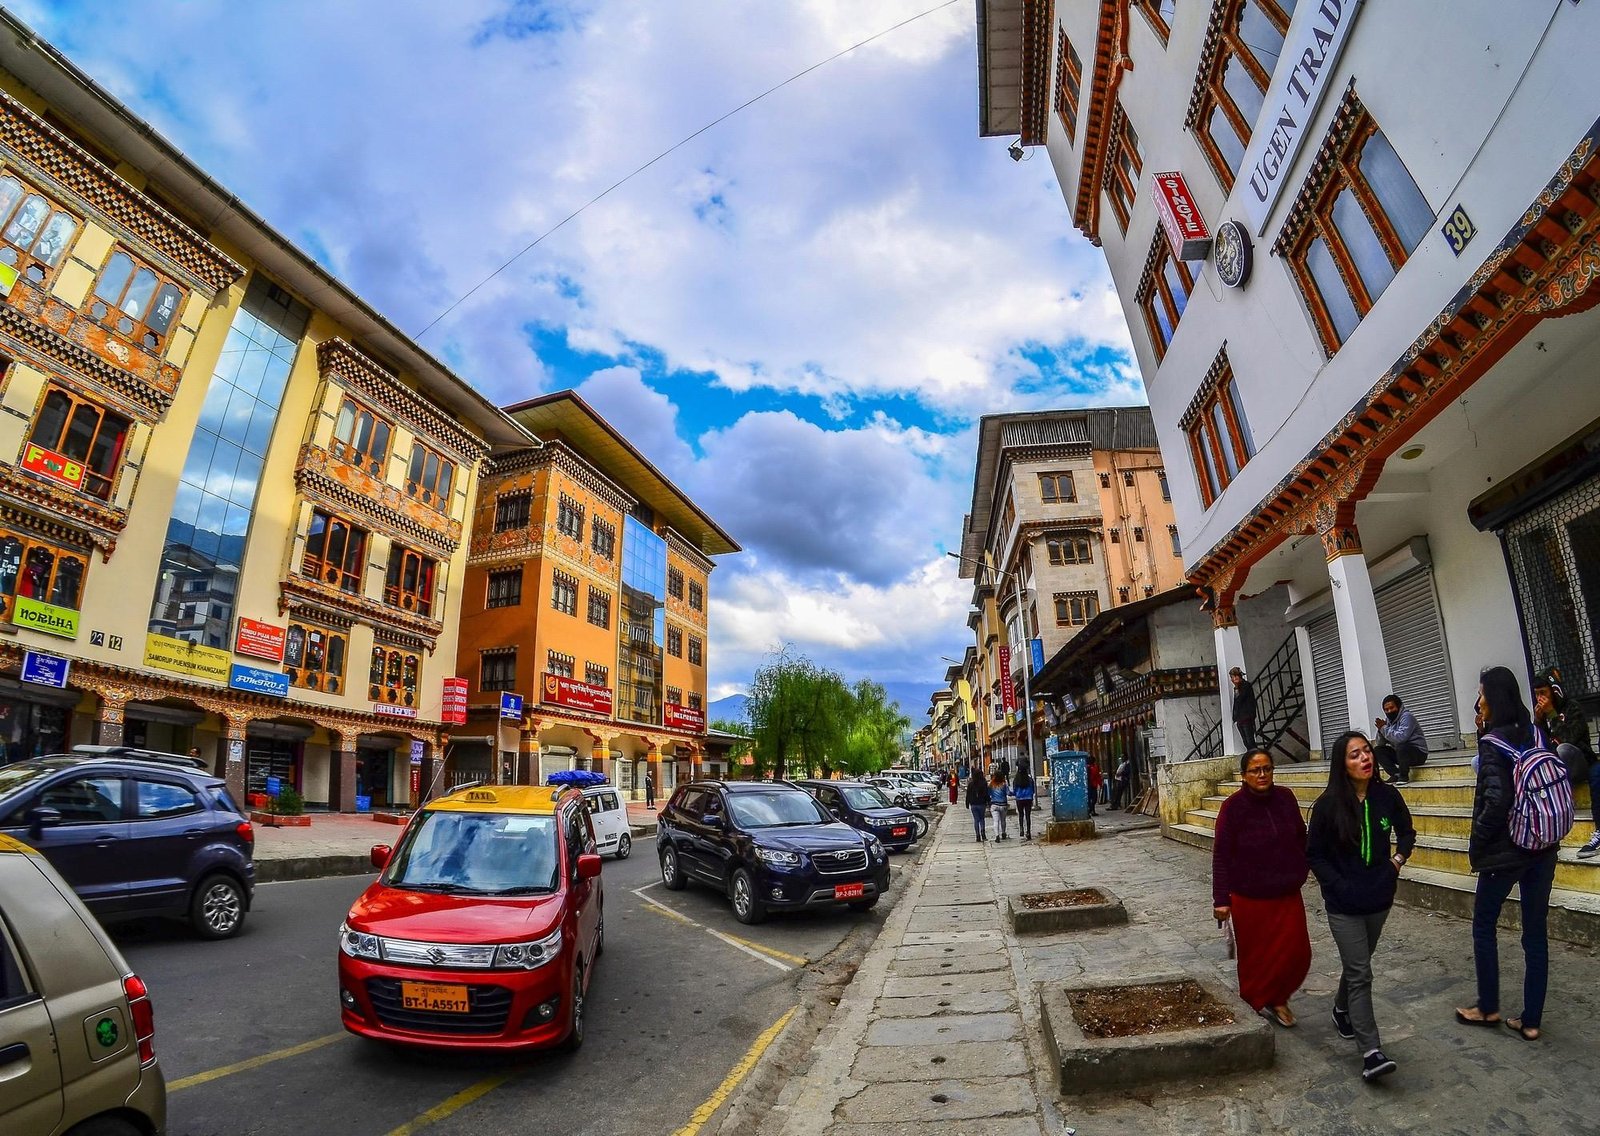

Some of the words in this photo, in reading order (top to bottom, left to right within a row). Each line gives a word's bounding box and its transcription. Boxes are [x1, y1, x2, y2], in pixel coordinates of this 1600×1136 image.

[1249, 104, 1297, 203] UGEN
[1286, 0, 1349, 108] TRAD
[1155, 171, 1180, 179] HOTEL
[1165, 179, 1200, 232] SINGYE
[1445, 211, 1472, 251] 39
[20, 607, 74, 630] NORLHA
[110, 636, 121, 650] 12
[147, 653, 173, 664] SAMDRUP
[196, 664, 227, 676] KHANGZANG
[470, 791, 489, 800] TAXI
[405, 997, 467, 1011] BT-1-A5517
